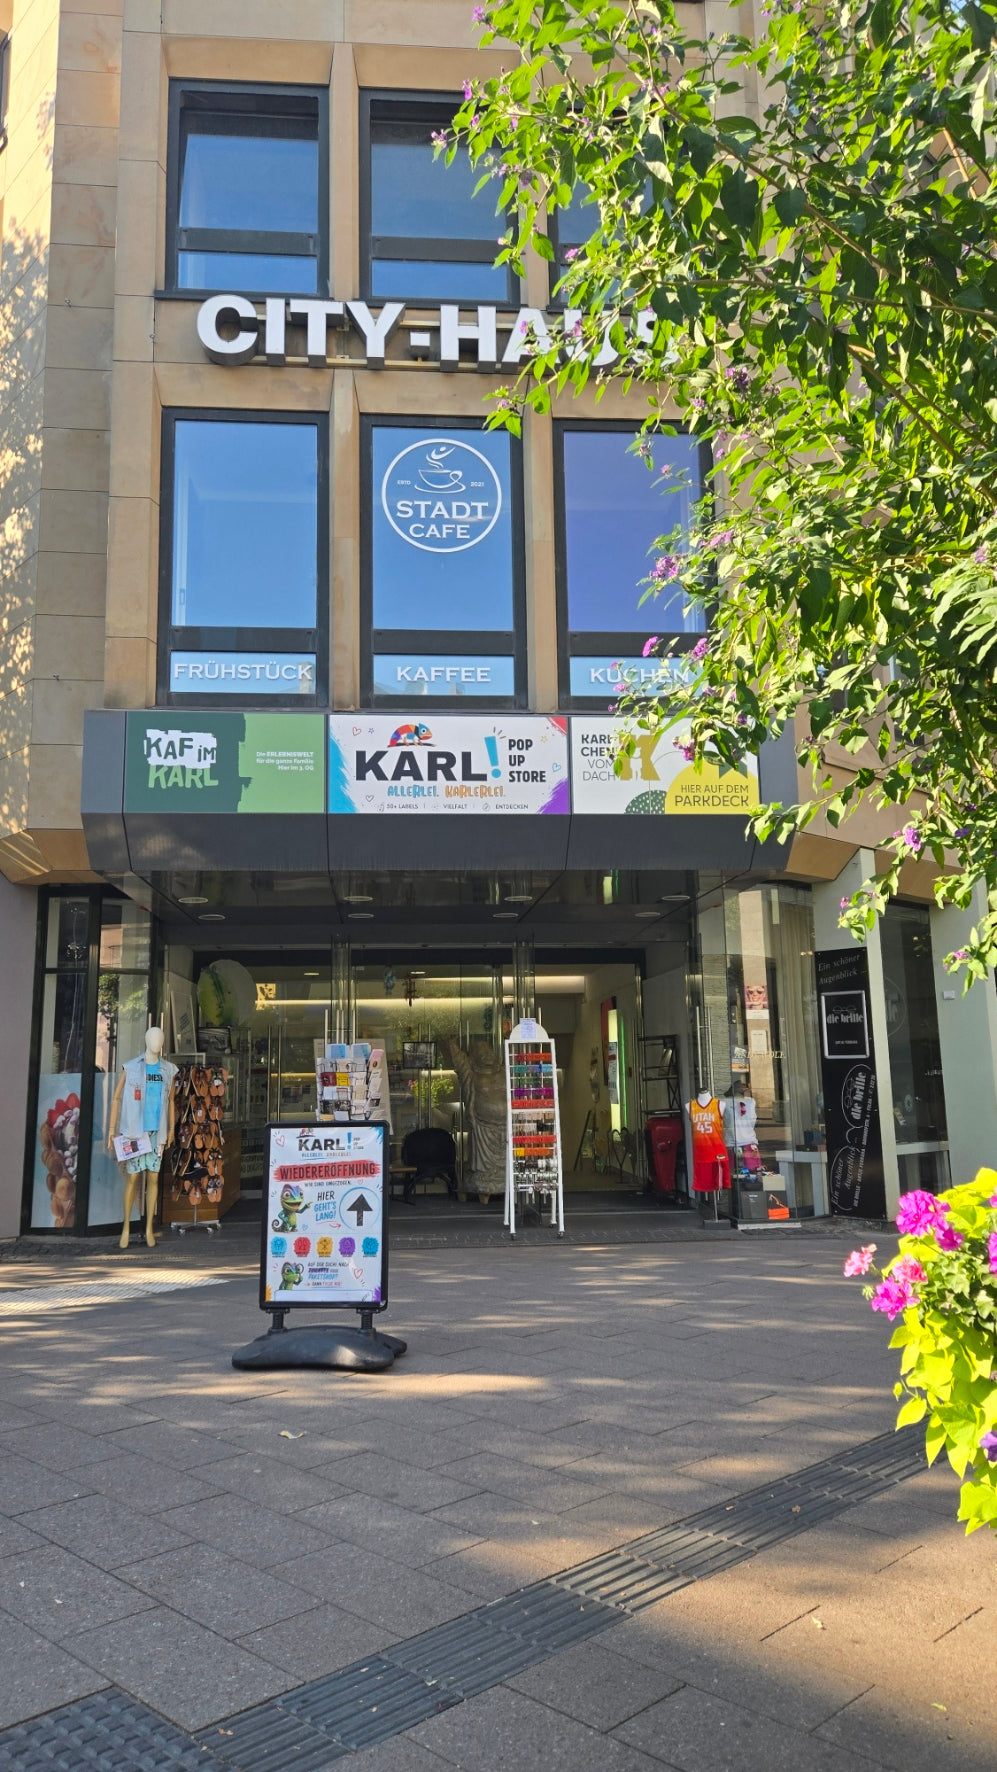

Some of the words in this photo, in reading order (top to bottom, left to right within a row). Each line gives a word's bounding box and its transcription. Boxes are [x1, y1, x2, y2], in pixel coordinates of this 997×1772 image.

[396, 500, 489, 520] STADT
[409, 524, 471, 539] CAFE
[173, 660, 313, 680] FRÜHSTÜCK
[396, 666, 492, 682] KAFFEE
[146, 736, 194, 760] KAF
[508, 738, 534, 751] POP
[508, 754, 526, 767] UP
[148, 764, 219, 789] KARL
[508, 770, 547, 783] STORE
[582, 771, 616, 781] DACH
[680, 785, 702, 793] HIER
[703, 784, 724, 793] AUF
[726, 785, 749, 794] DEM
[674, 795, 749, 807] PARKDECK
[826, 1013, 840, 1024] die
[840, 1012, 864, 1024] brille
[692, 1112, 715, 1123] UTAH
[696, 1121, 713, 1134] 45
[280, 1162, 376, 1180] WIEDERERÖFFNUNG
[317, 1190, 335, 1201] HIER
[315, 1211, 337, 1222] LANG!
